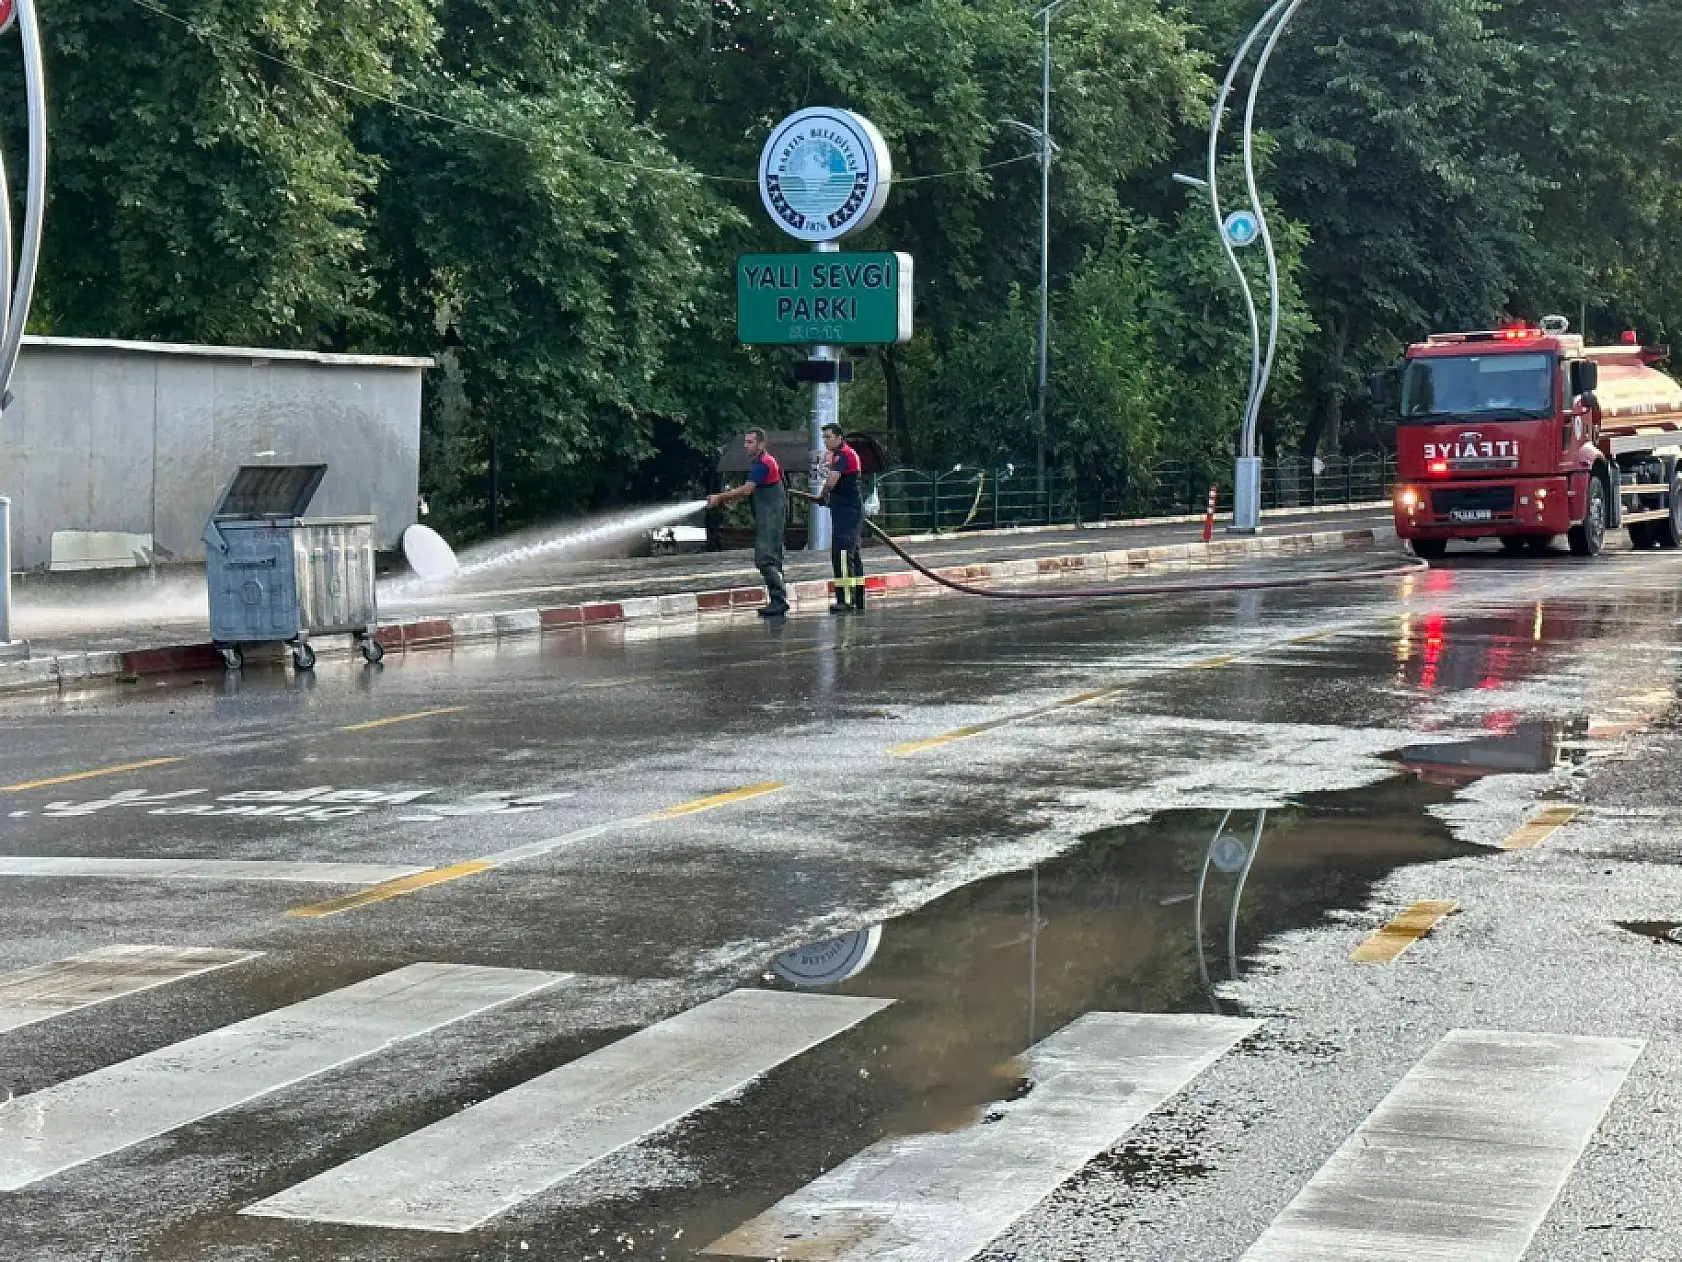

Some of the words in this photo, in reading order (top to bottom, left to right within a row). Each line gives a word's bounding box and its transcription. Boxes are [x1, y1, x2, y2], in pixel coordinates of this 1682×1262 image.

[743, 264, 800, 290] YALI
[811, 257, 892, 290] SEVGİ
[776, 295, 858, 323] PARKI
